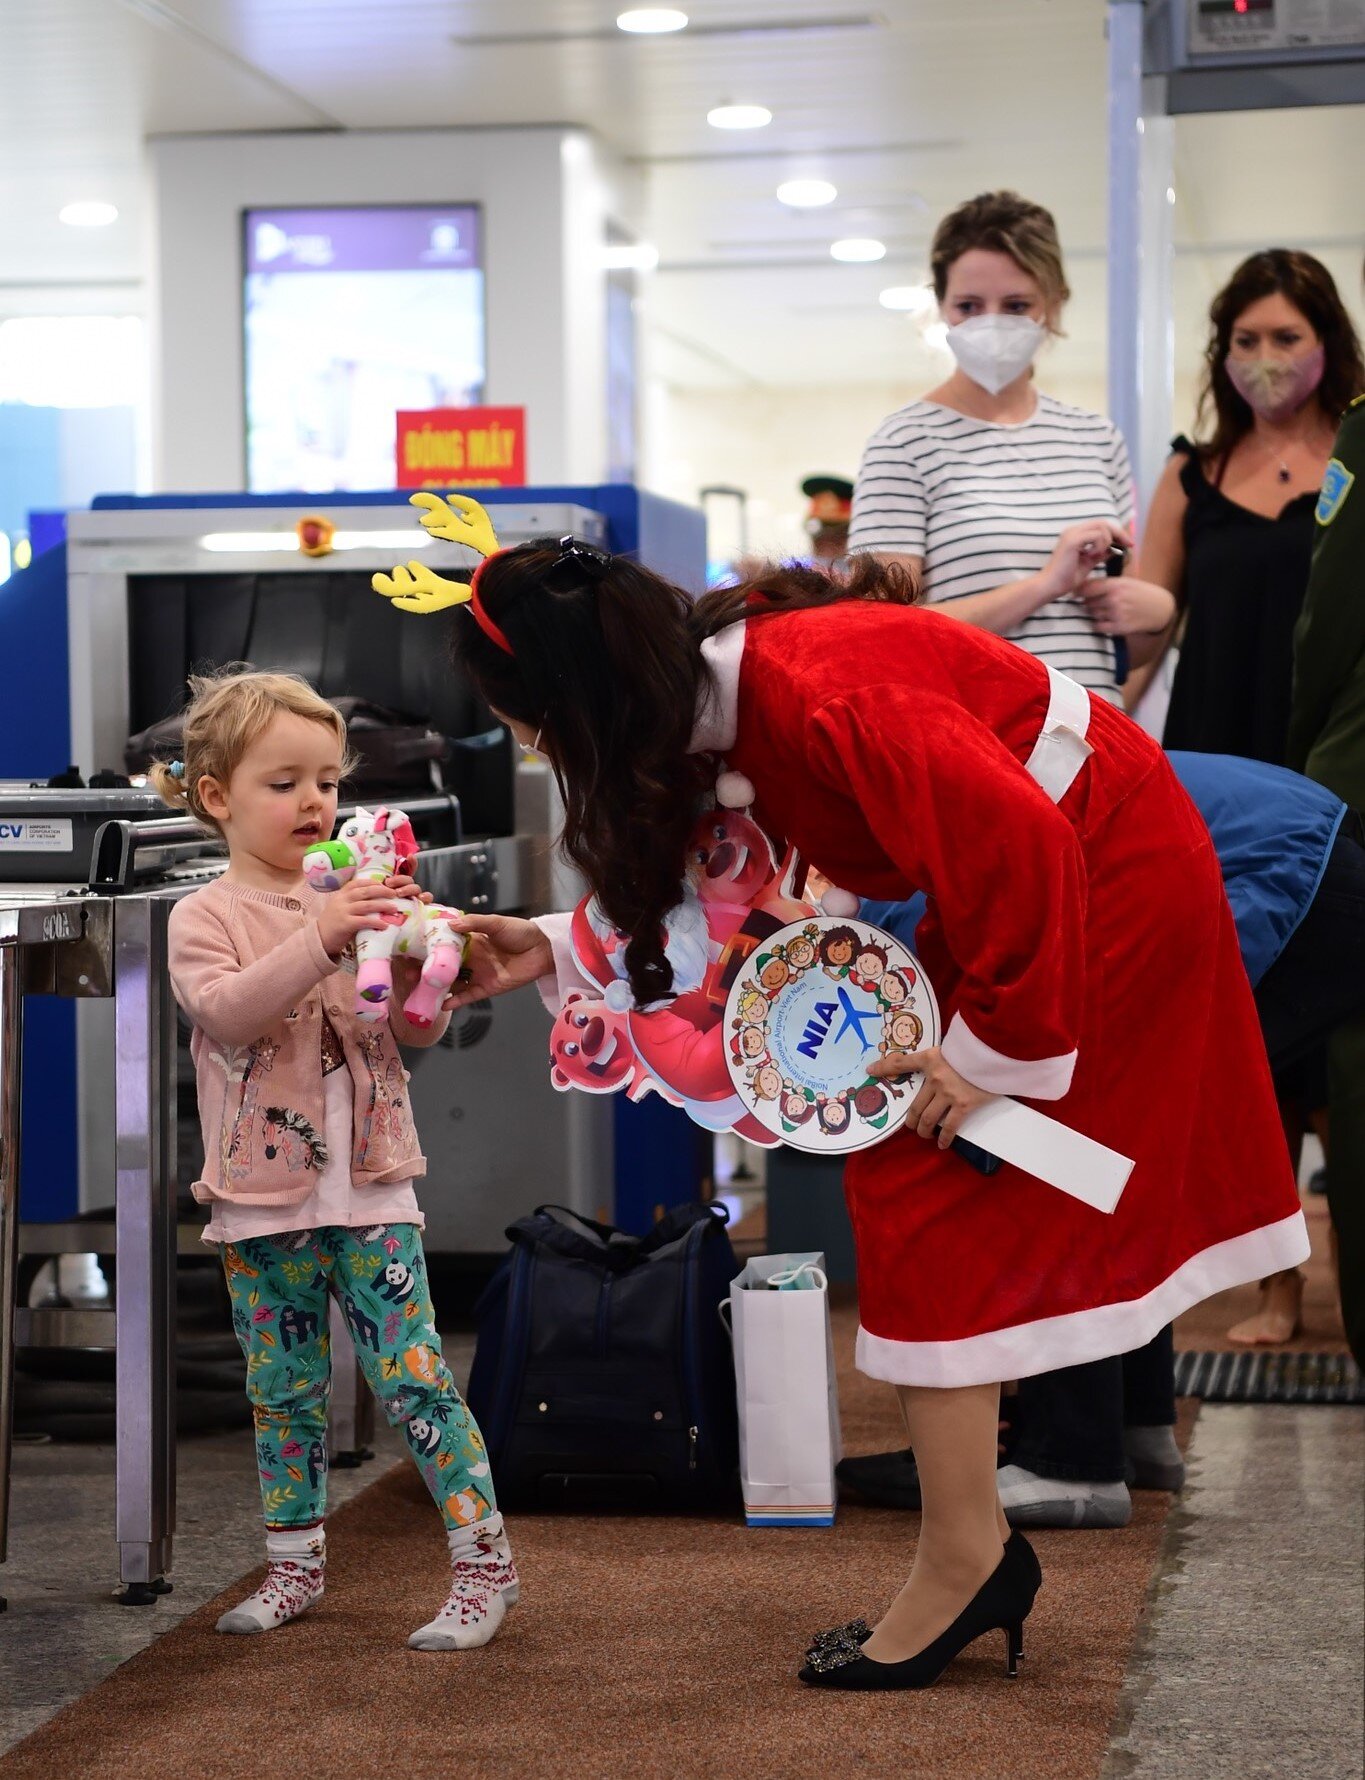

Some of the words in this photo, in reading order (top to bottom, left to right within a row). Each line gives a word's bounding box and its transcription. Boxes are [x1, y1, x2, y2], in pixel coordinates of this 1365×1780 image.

[467, 420, 515, 468] MÁY
[774, 1040, 805, 1084] International
[791, 981, 807, 996] Nam
[796, 1002, 839, 1060] NIA
